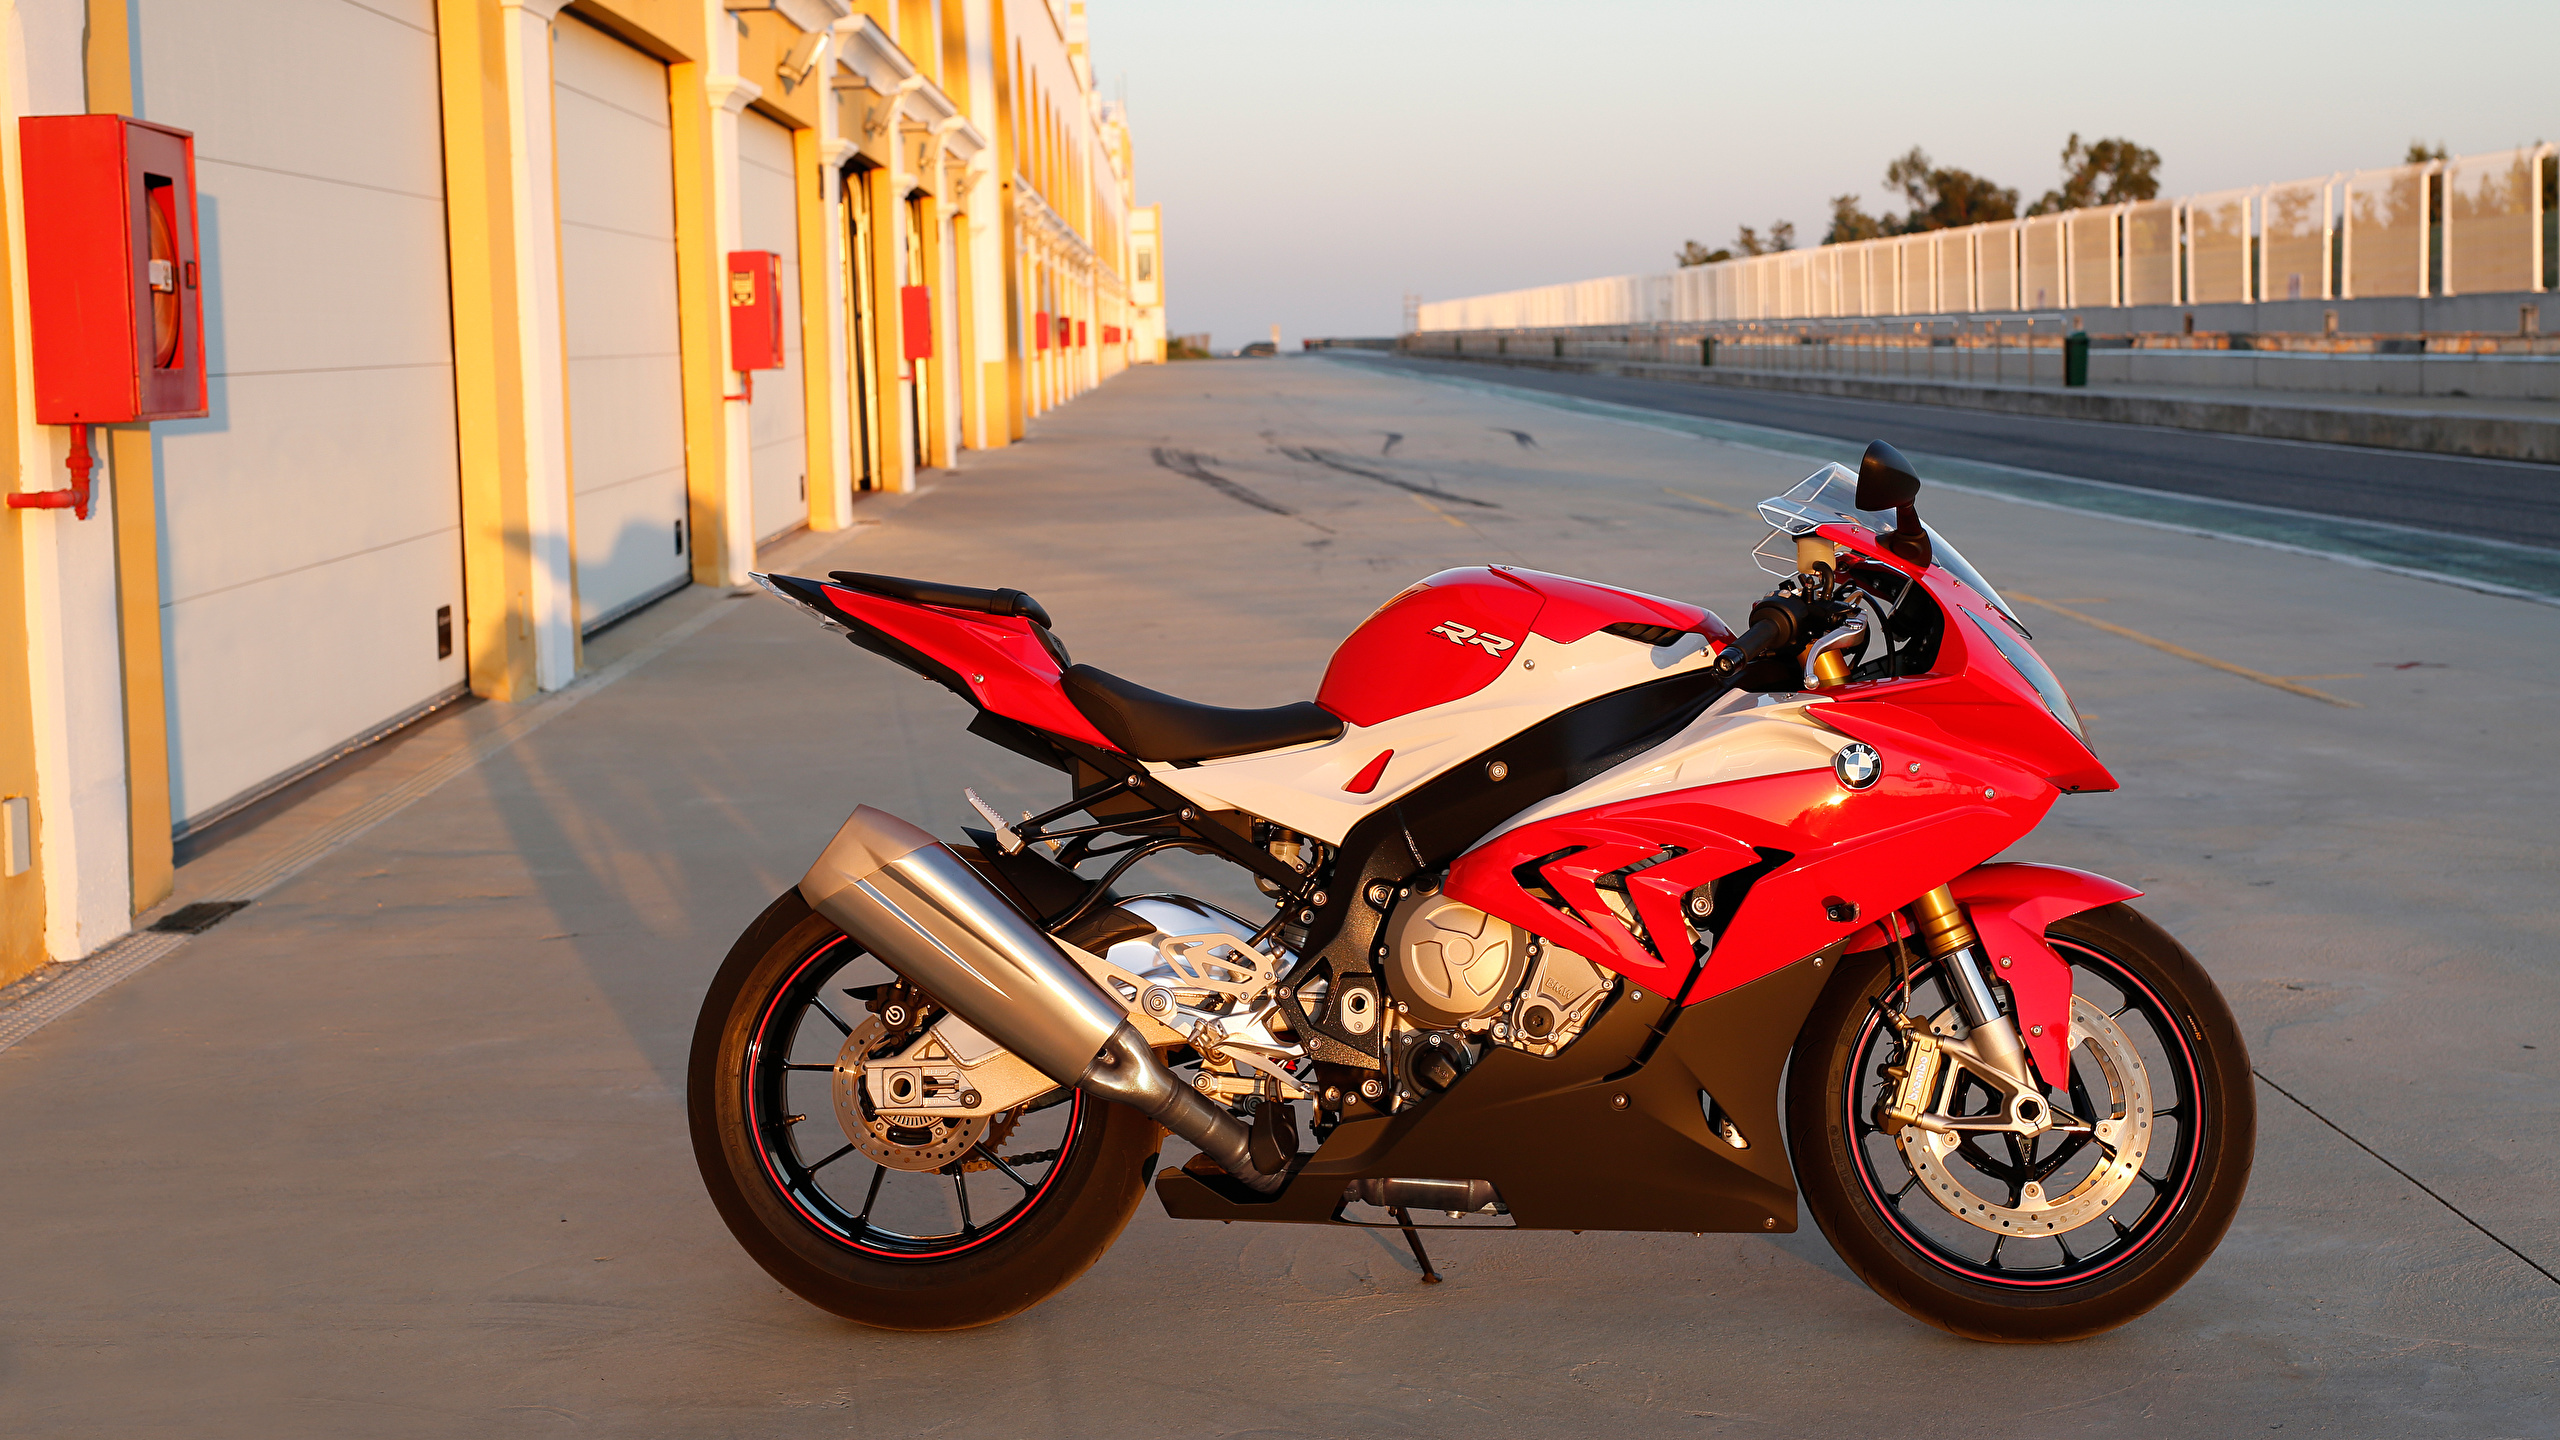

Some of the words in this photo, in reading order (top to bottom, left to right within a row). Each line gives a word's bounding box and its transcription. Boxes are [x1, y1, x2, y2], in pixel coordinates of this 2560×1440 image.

[1431, 620, 1515, 658] RR
[1841, 744, 1878, 761] BMW
[1545, 977, 1575, 999] BMW
[1908, 1056, 1928, 1100] brembo
